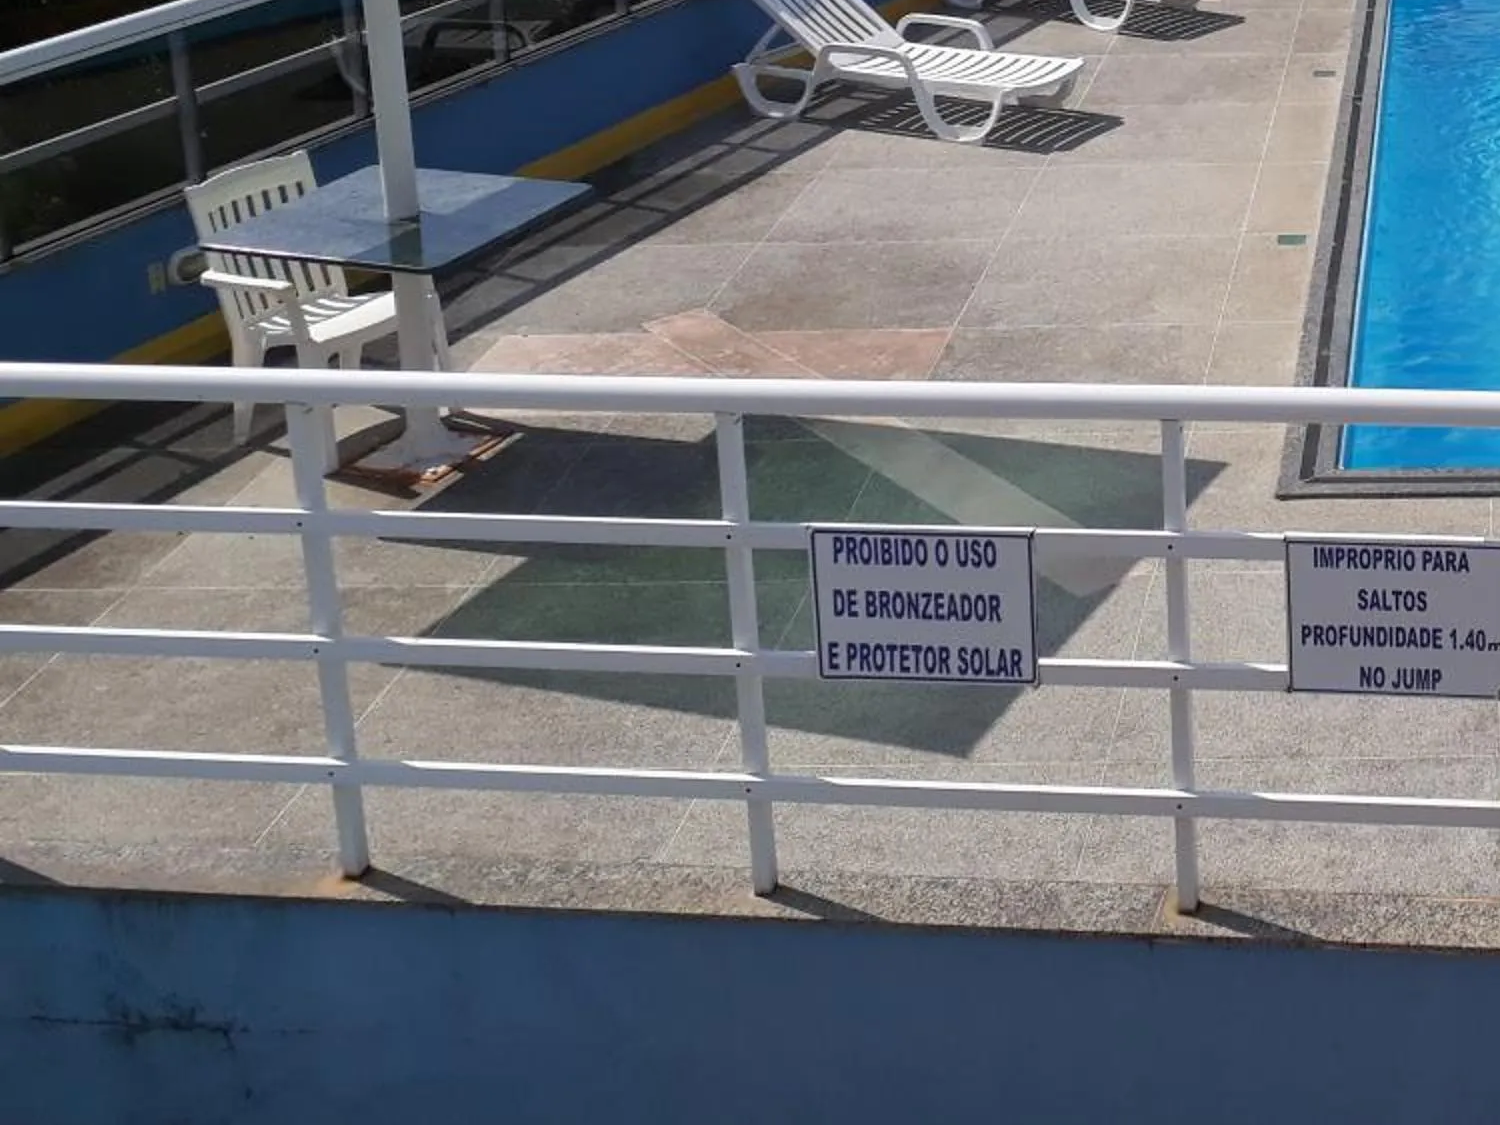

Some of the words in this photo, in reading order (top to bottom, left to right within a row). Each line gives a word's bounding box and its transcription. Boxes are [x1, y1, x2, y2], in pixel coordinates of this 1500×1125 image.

[833, 536, 928, 567] PROIBIDO
[935, 538, 948, 567] O
[956, 539, 997, 568] USO
[1313, 546, 1415, 571] IMPROPRIO
[1422, 550, 1470, 572] PARA
[833, 589, 859, 617] DE
[865, 590, 1002, 622] BRONZEADOR
[1357, 589, 1427, 612] SALTOS
[1301, 625, 1443, 649] PROFUNDIDADE
[828, 642, 839, 670] E
[847, 643, 950, 674] PROTETOR
[957, 647, 1023, 677] SOLAR
[1360, 666, 1385, 688] NO
[1391, 668, 1442, 691] JUMP
